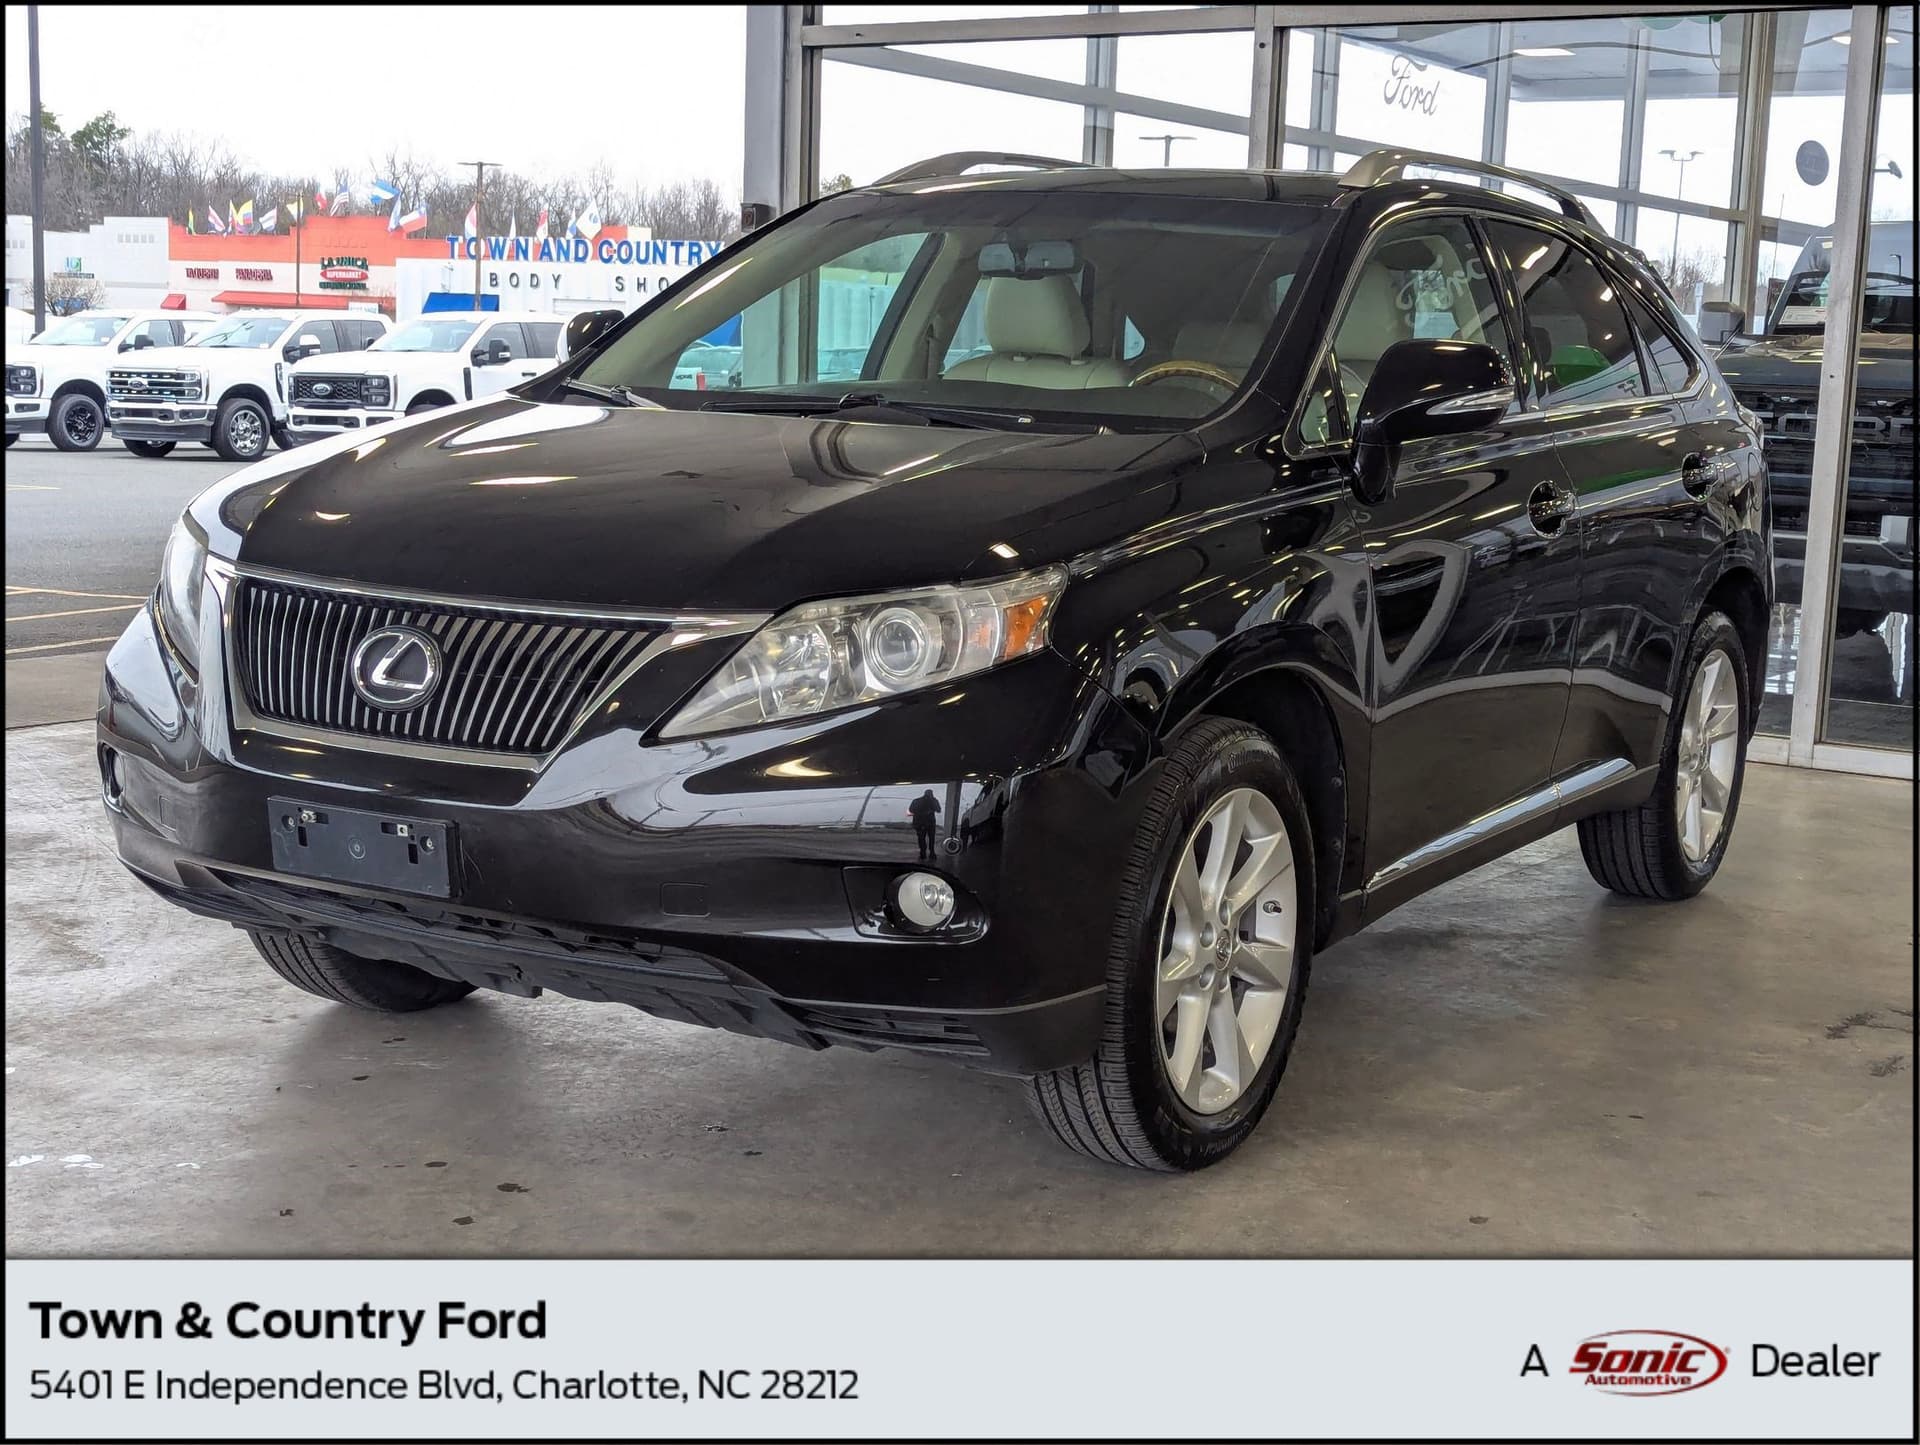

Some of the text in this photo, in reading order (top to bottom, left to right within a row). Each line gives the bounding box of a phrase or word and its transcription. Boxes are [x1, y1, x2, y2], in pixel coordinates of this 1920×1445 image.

[1384, 54, 1440, 116] Ford
[447, 236, 721, 265] TOWN AND COUNTRY
[489, 272, 669, 293] BODY SHO
